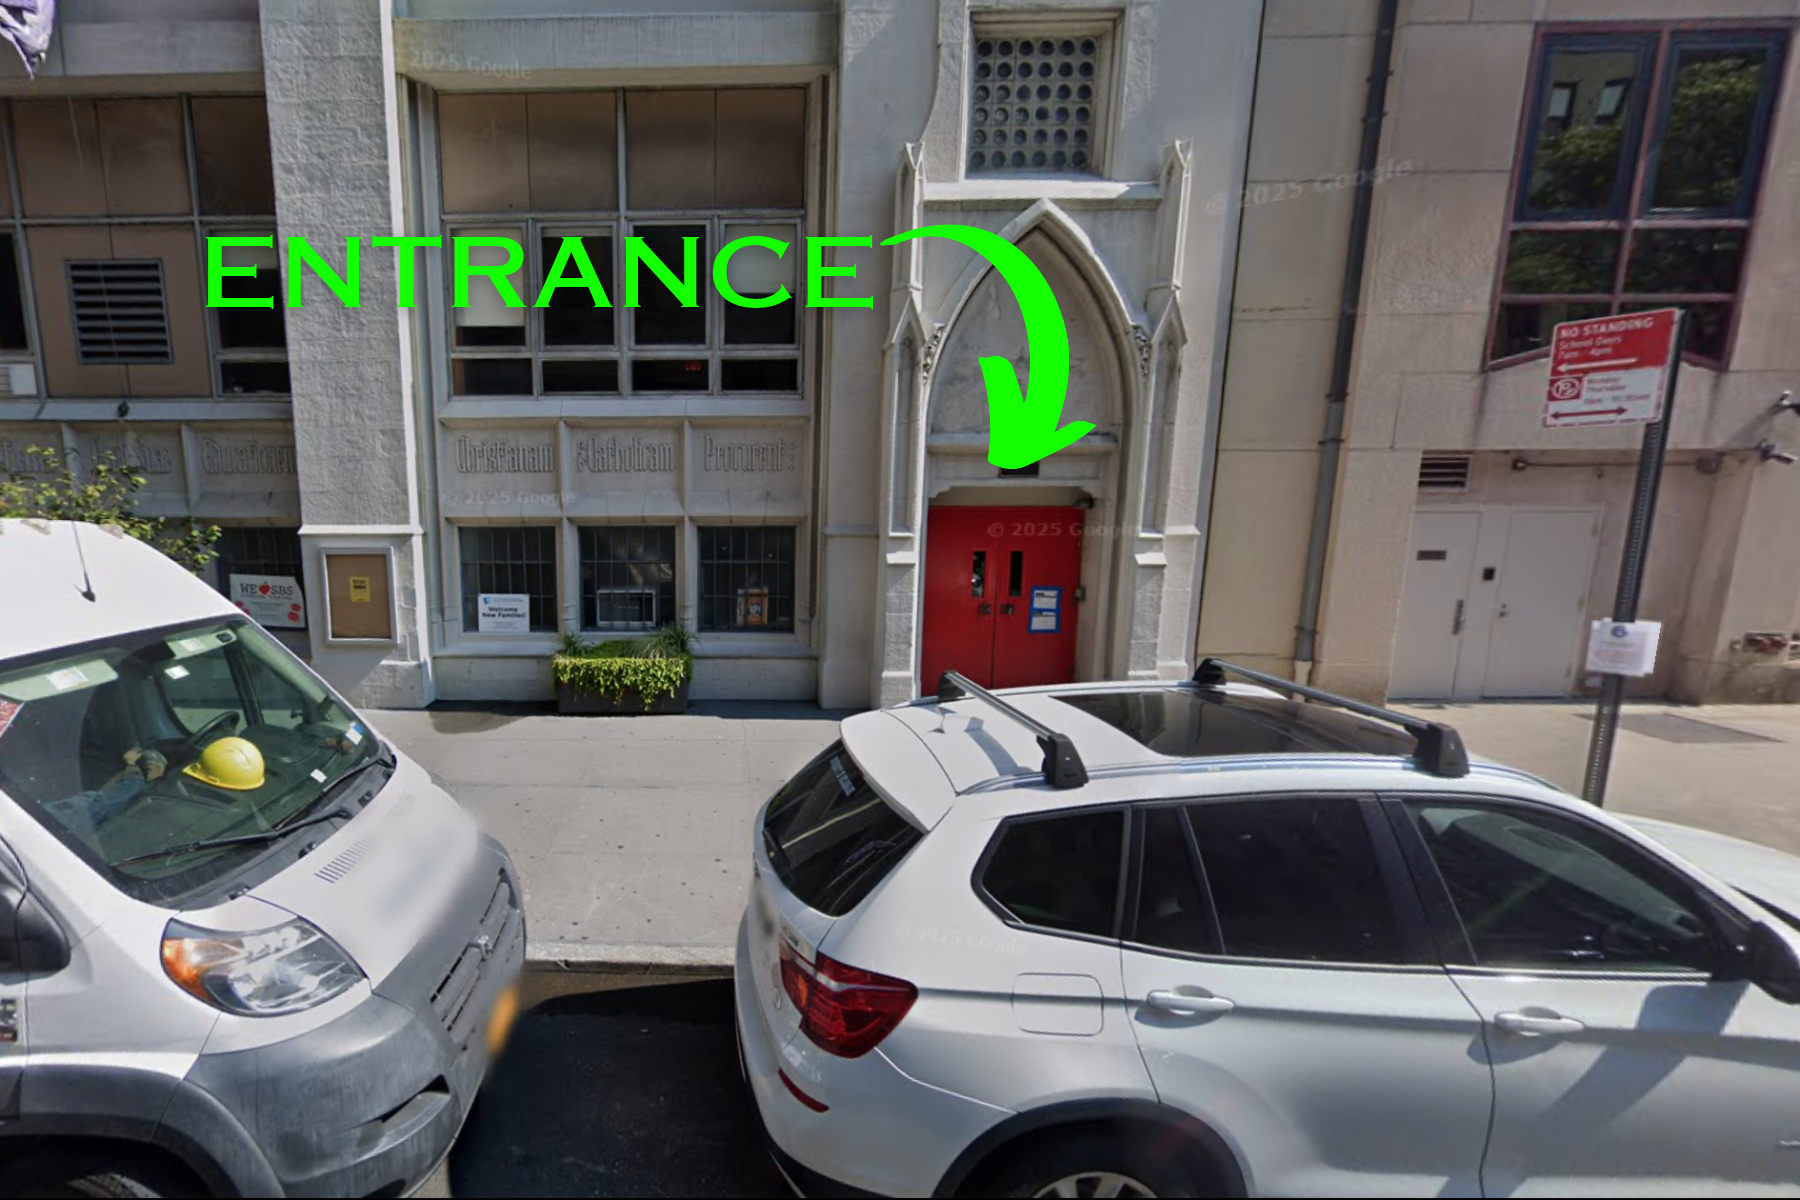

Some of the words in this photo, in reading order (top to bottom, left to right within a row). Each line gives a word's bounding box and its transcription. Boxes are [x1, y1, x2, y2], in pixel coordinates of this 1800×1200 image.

[1560, 326, 1579, 339] NO
[1582, 318, 1654, 336] STANDING
[1559, 338, 1593, 350] School
[239, 583, 258, 595] WE
[271, 585, 293, 596] SBS
